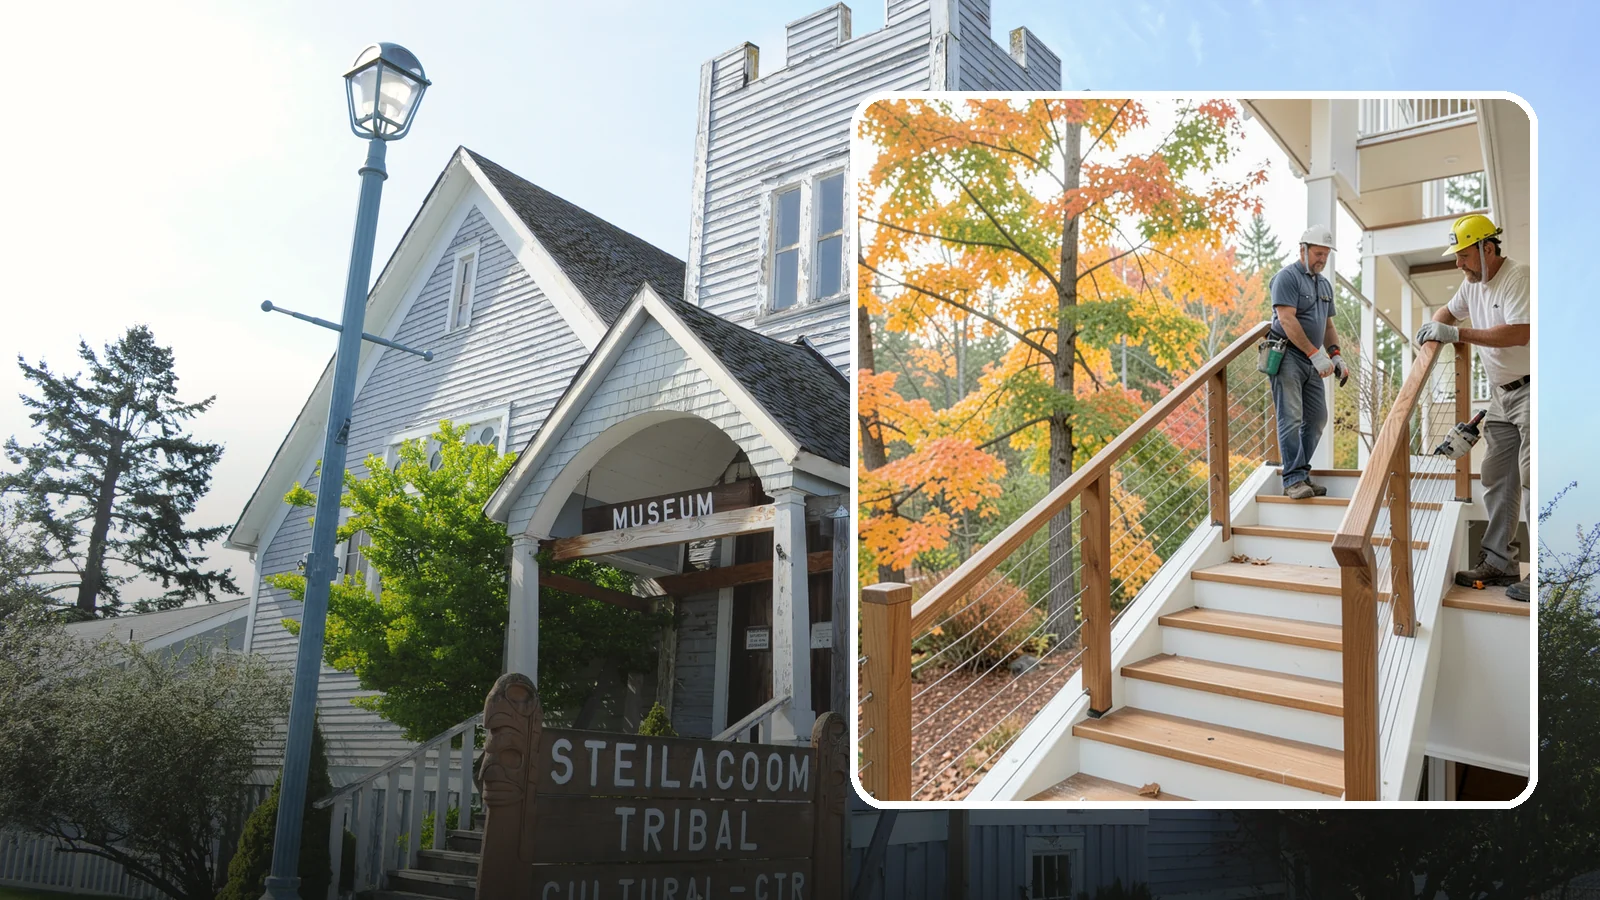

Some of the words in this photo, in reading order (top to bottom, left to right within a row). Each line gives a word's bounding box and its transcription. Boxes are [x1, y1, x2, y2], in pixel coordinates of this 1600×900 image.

[613, 491, 713, 531] MUSEUM
[550, 738, 809, 793] STEILACOOM
[614, 806, 757, 852] TRIBAL
